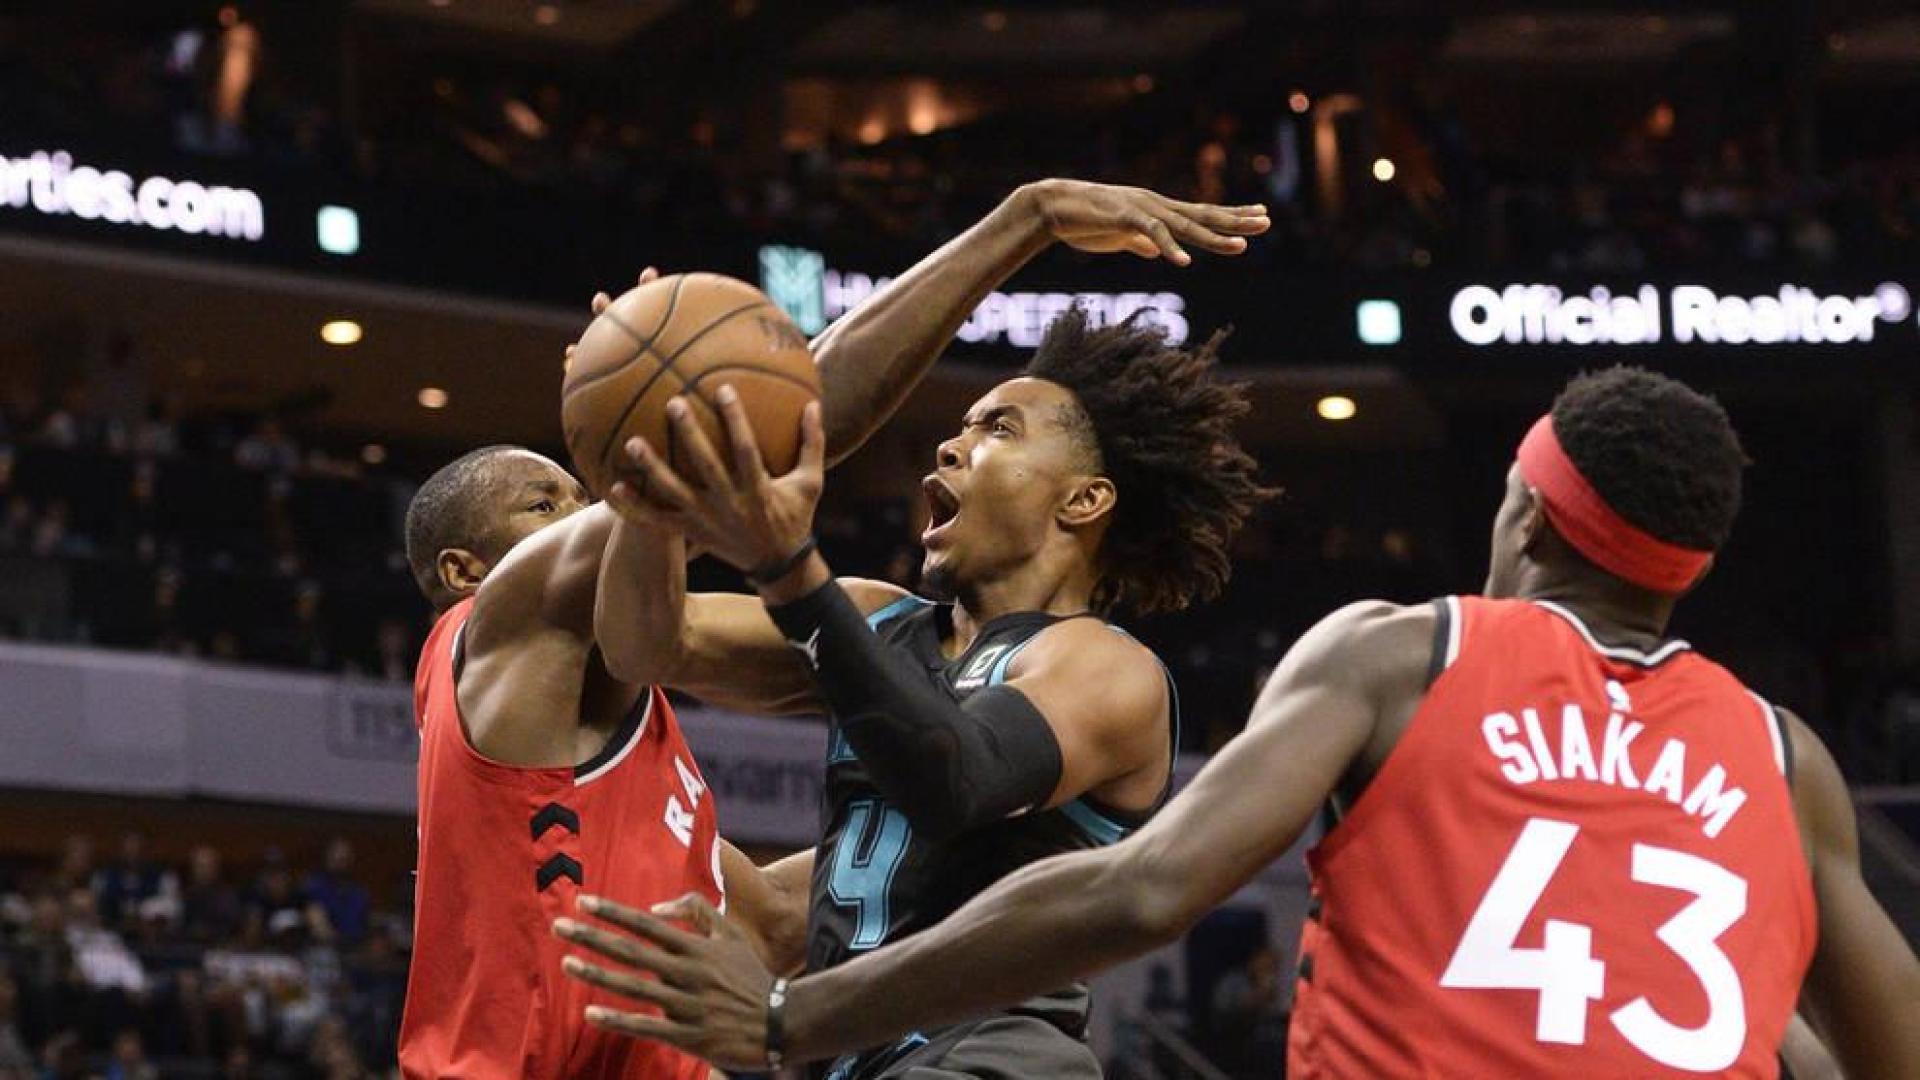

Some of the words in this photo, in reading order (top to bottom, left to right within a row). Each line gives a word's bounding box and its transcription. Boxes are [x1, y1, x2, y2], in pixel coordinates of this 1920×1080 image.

[0, 151, 264, 240] rties.com
[1450, 284, 1661, 345] Official
[1481, 703, 1748, 839] SIAKAM
[828, 800, 912, 950] 4
[1439, 817, 1749, 1073] 43
